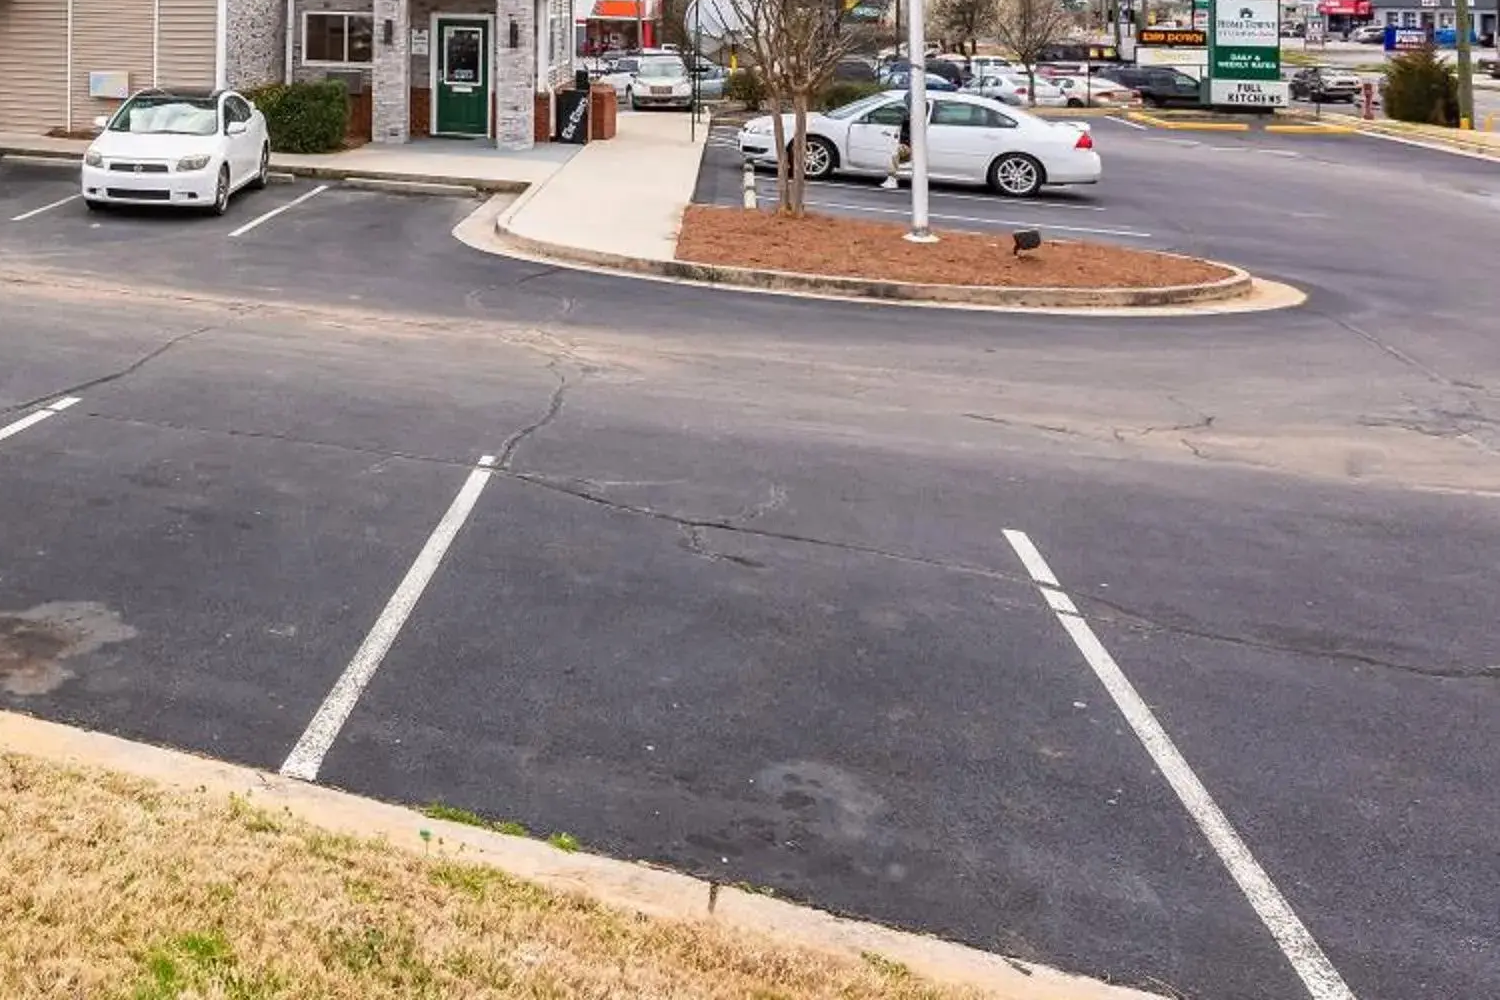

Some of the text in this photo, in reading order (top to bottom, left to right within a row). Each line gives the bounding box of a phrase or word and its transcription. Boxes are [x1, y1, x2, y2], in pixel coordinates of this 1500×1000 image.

[1217, 61, 1249, 69] WEEKLY
[1237, 83, 1262, 93] FULL
[1228, 93, 1283, 104] KITCHENS
